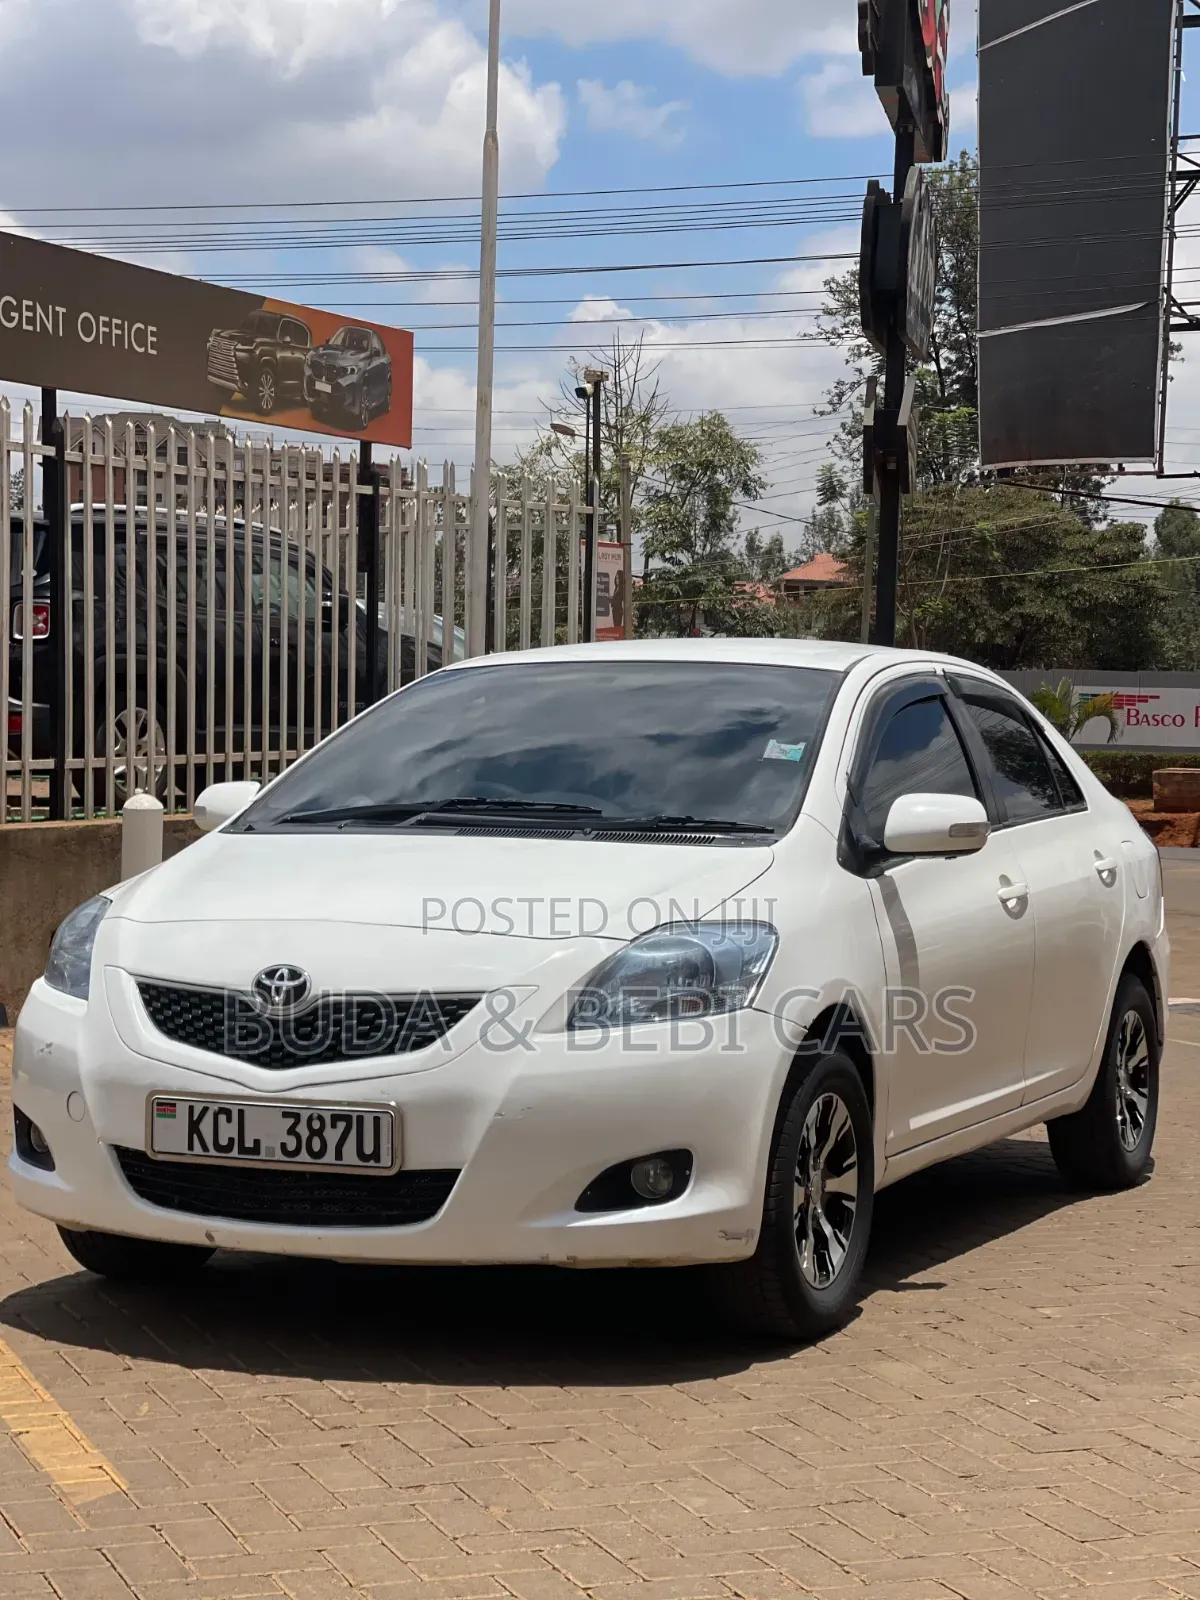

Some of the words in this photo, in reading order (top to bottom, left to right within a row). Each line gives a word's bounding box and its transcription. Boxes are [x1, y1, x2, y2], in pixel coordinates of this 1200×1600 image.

[0, 295, 67, 337] GENT
[77, 311, 158, 355] OFFICE
[187, 1105, 261, 1156] KCL
[279, 1111, 382, 1164] 387U
